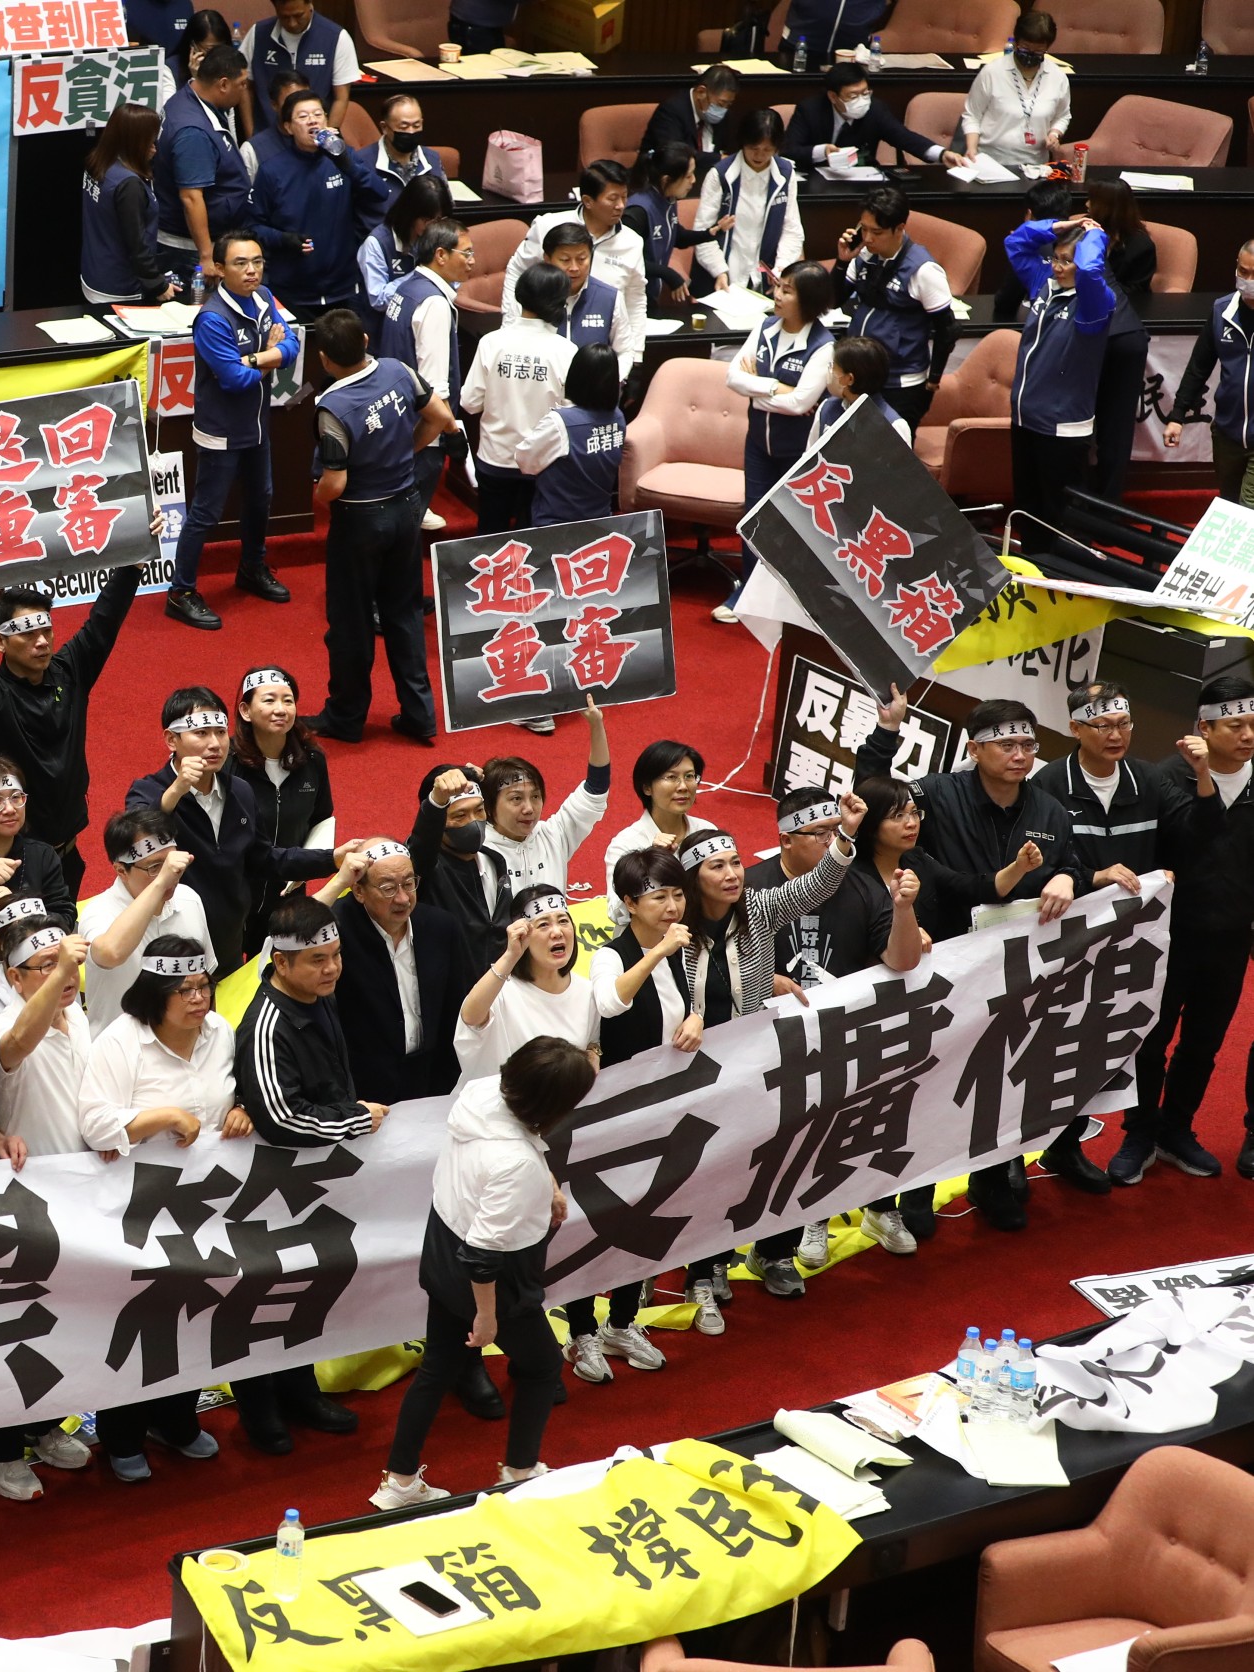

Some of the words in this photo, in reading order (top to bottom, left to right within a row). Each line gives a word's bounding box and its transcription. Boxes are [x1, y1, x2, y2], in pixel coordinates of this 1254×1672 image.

[17, 47, 160, 129] 反貪污
[497, 361, 548, 382] 柯志恩
[504, 353, 541, 365] 立法委員
[586, 430, 624, 455] 邱若華
[465, 532, 635, 616] 退回
[786, 453, 963, 657] 反黑箱
[479, 605, 639, 703] 重審
[31, 928, 65, 951] 民主
[546, 896, 1167, 1290] 反擴權
